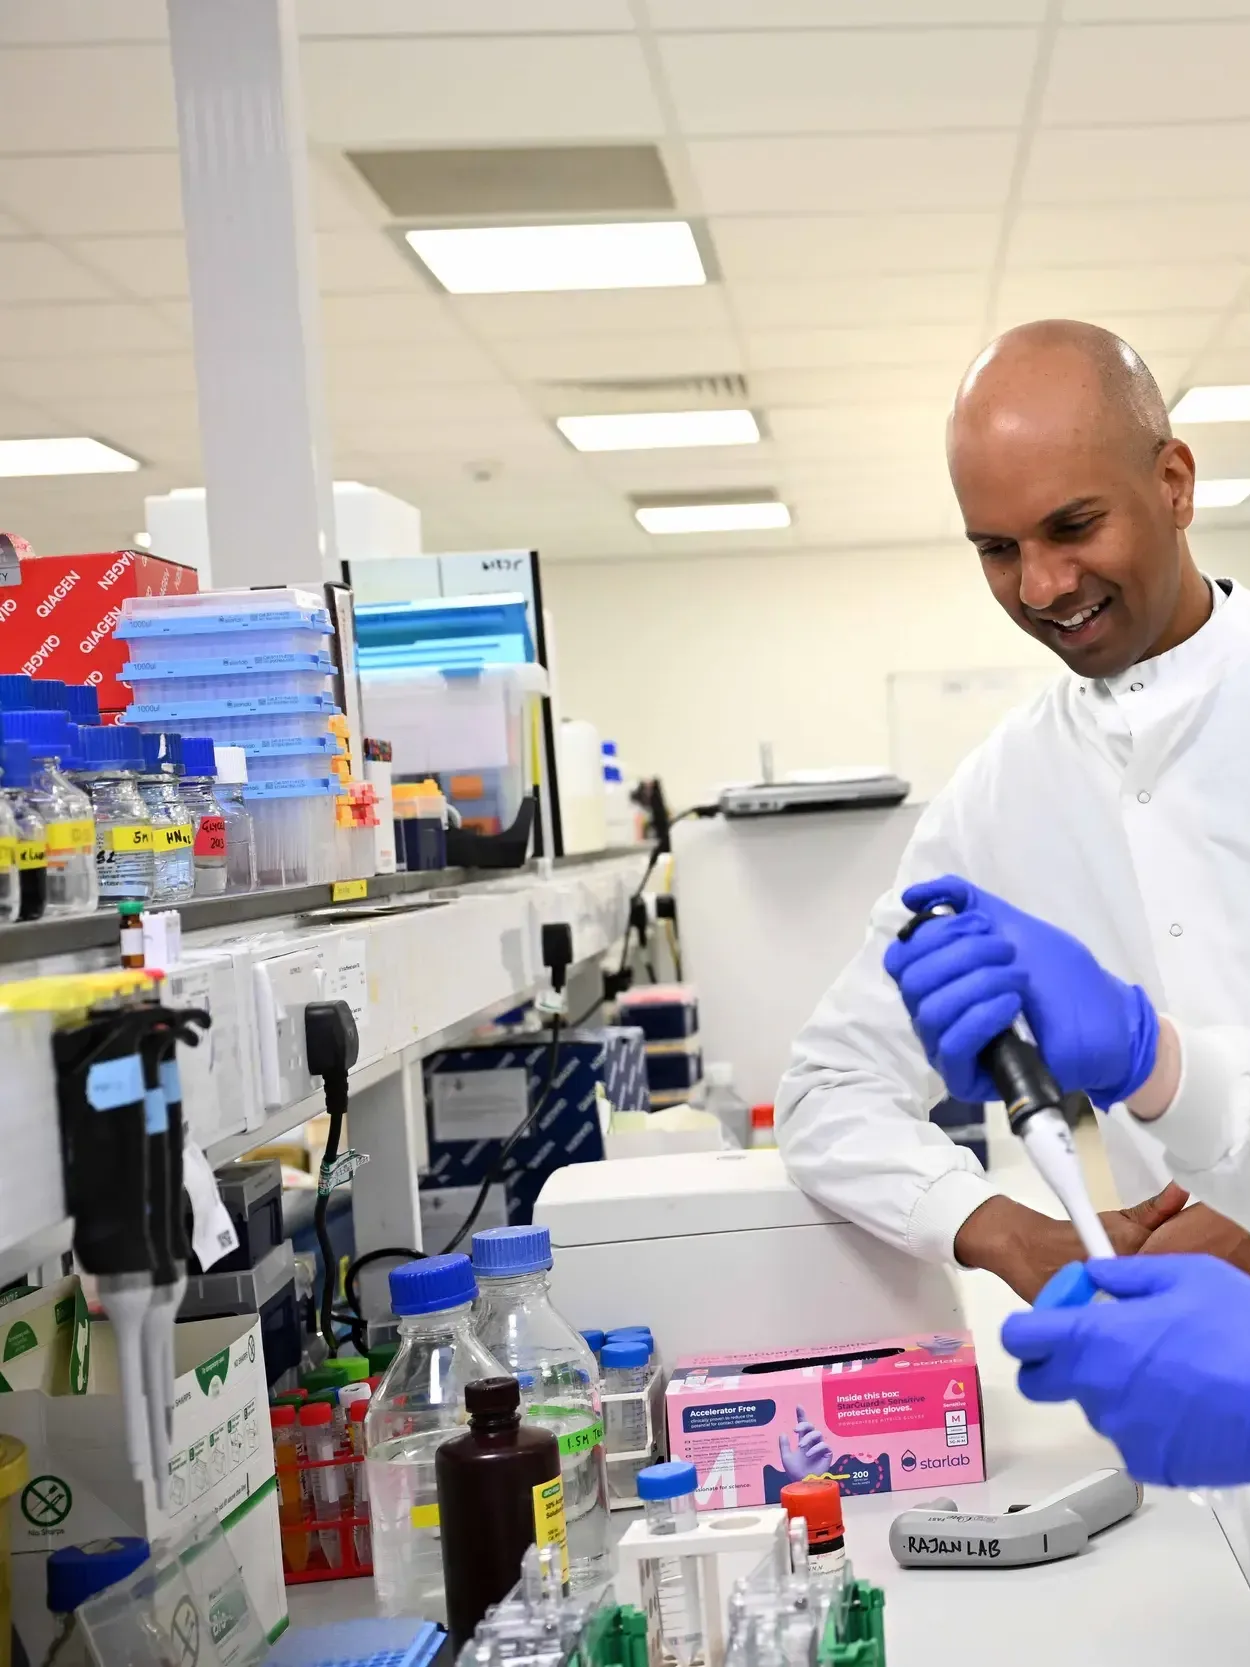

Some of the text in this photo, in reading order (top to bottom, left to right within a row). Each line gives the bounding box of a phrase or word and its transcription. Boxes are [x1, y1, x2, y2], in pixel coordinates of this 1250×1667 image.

[97, 550, 135, 591] IAGEN
[36, 569, 81, 618] QIAGEN
[79, 606, 123, 654] QIAGEN
[836, 1390, 900, 1403] Inside this box:
[887, 1395, 926, 1405] Sensitive
[690, 1405, 756, 1417] Accelerator Free
[837, 1404, 912, 1420] protective gloves.
[951, 1415, 960, 1423] M
[567, 1434, 590, 1450] 1.5M
[920, 1453, 970, 1470] starlab
[852, 1470, 869, 1479] 200
[41, 1527, 65, 1536] Sharps
[908, 1536, 962, 1554] RAJAN
[967, 1539, 1001, 1558] LAB
